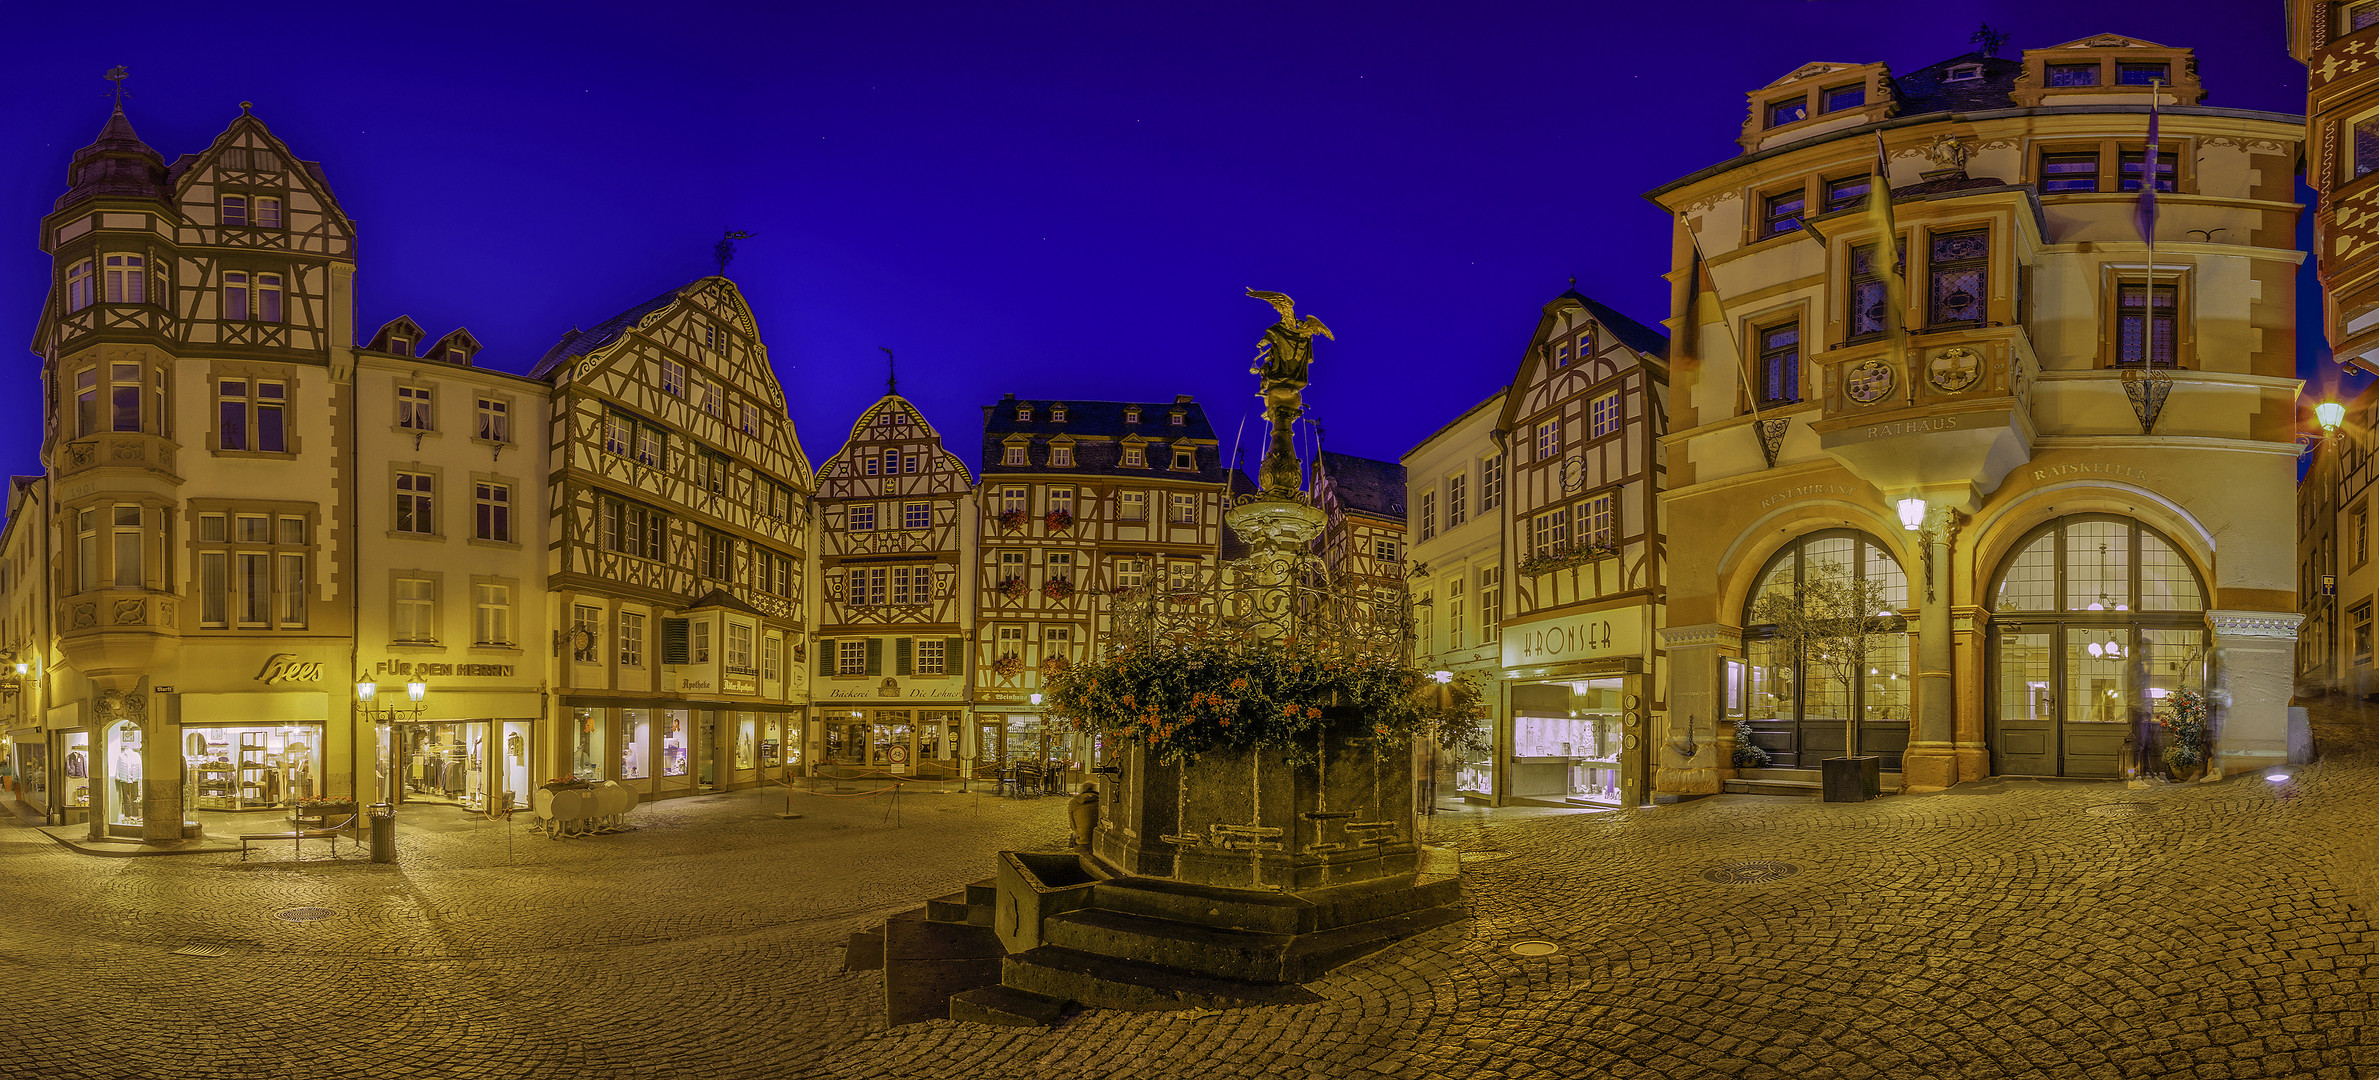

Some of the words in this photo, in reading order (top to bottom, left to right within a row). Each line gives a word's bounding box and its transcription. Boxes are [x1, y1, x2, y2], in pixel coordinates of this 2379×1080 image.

[1867, 416, 1957, 438] RATHAUS
[2033, 462, 2148, 480] RATSKELLER
[1760, 484, 1857, 509] RESTAURANT
[1523, 619, 1611, 657] KRONSER
[254, 653, 325, 686] Hees
[376, 659, 412, 676] FÜR
[417, 662, 453, 676] DEN
[456, 663, 515, 677] HERRN
[682, 678, 711, 691] Apotheke
[829, 685, 870, 698] Bäckerei
[909, 688, 928, 698] Die
